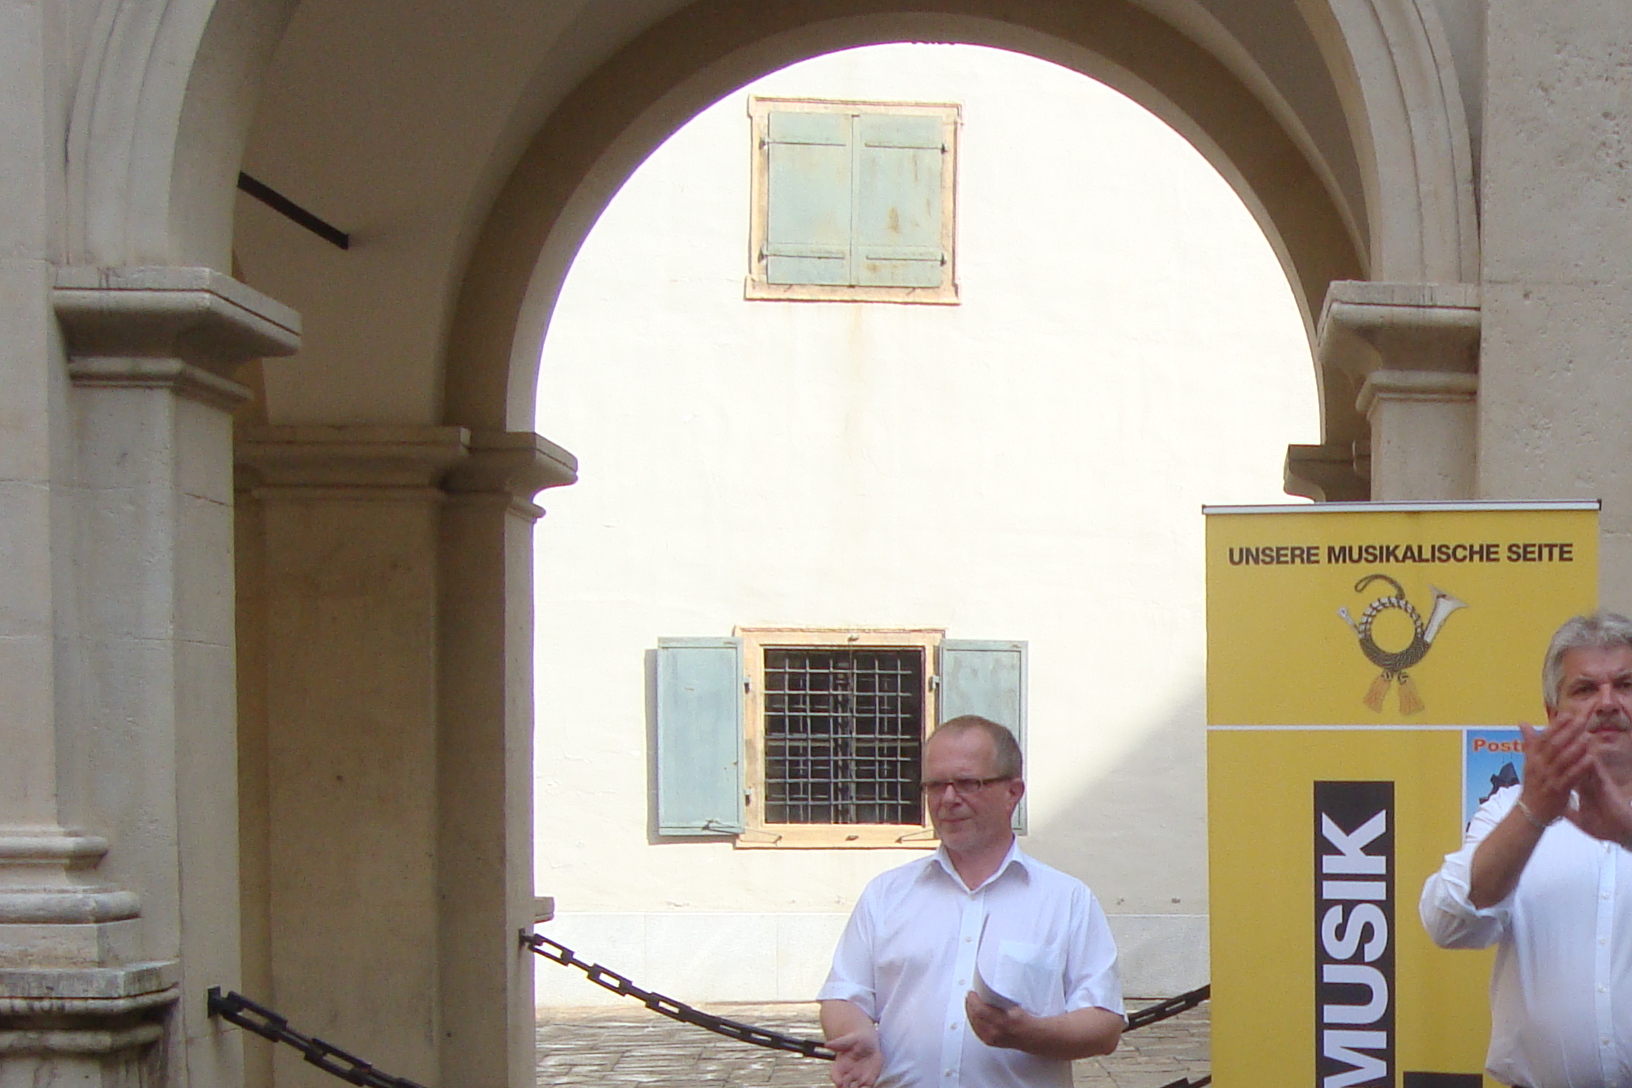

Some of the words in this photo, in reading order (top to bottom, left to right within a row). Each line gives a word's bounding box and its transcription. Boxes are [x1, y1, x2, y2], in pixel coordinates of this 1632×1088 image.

[1228, 546, 1321, 566] UNSERE
[1327, 543, 1501, 565] MUSIKALISCHE
[1506, 543, 1574, 563] SEITE
[1472, 738, 1526, 753] Post
